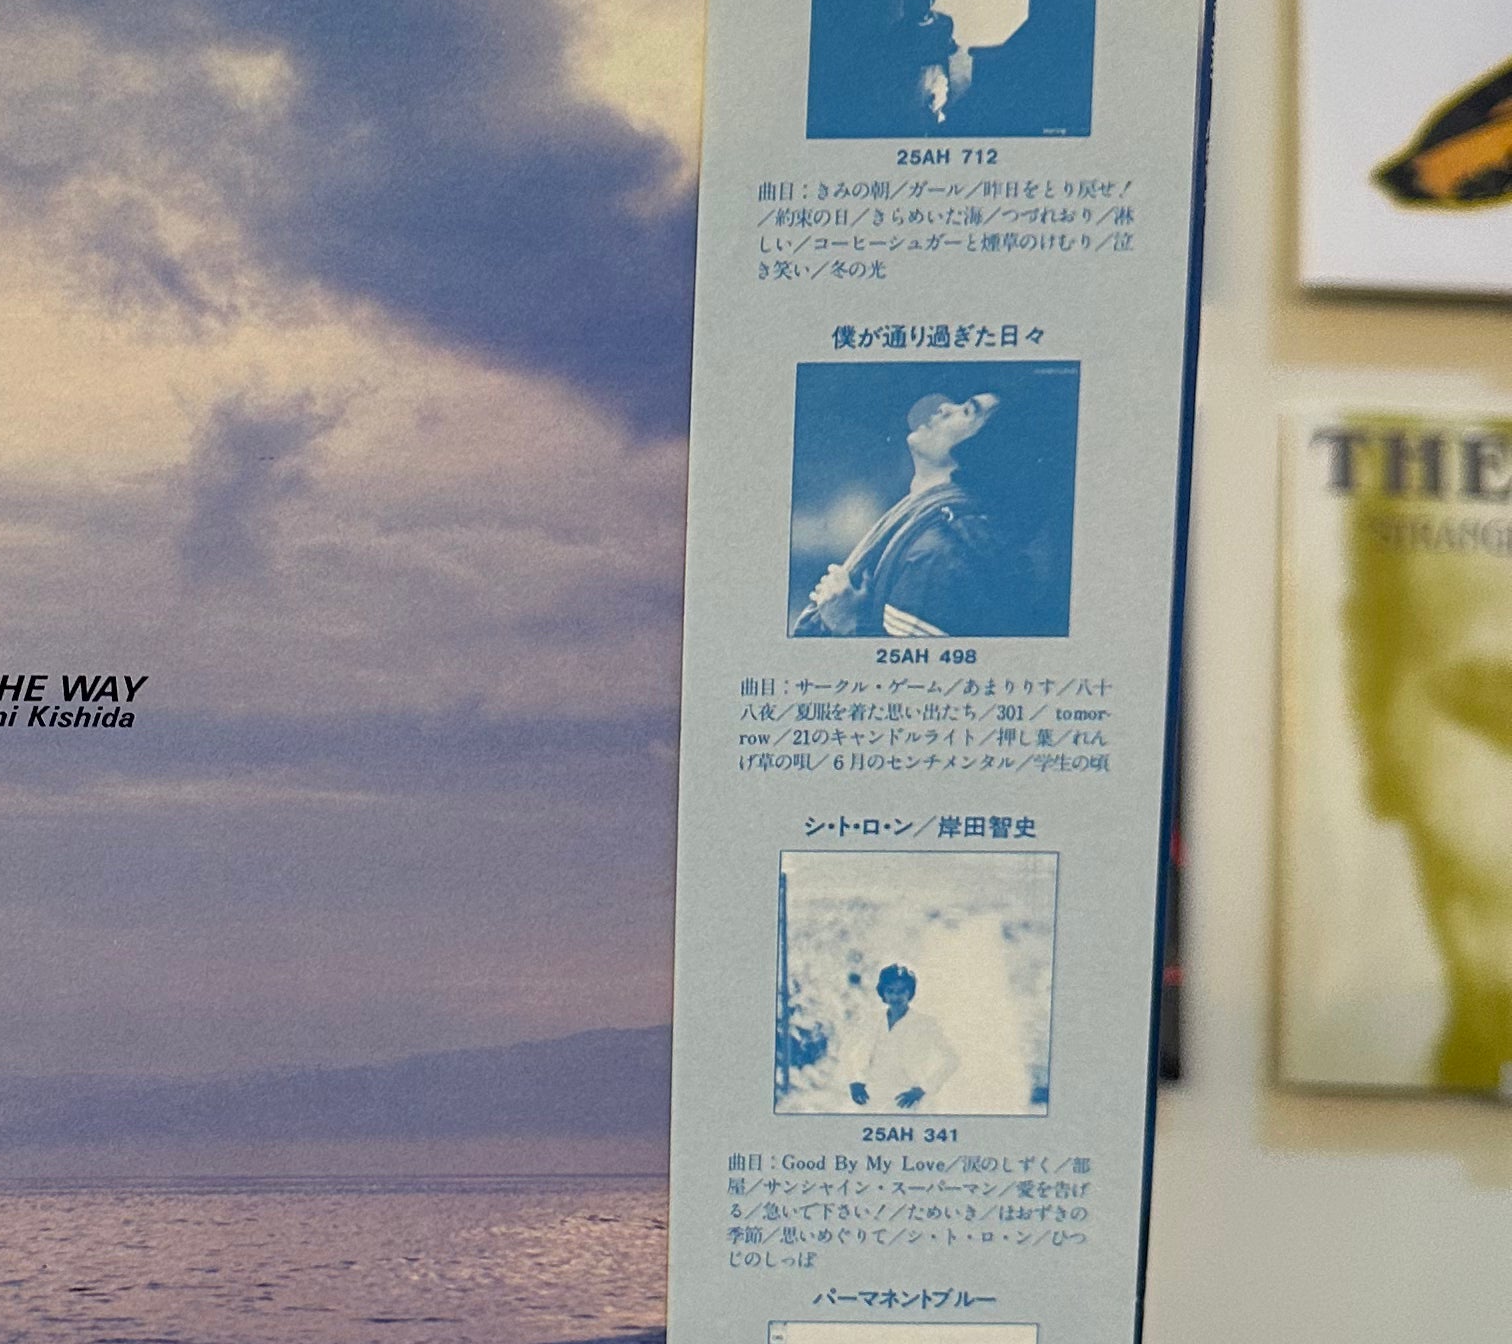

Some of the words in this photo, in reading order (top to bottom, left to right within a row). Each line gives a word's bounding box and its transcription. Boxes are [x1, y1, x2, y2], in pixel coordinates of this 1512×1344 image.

[896, 149, 950, 166] 25AH
[962, 149, 999, 166] 712
[831, 323, 1045, 350] 僕が通り過ぎた日々
[875, 648, 929, 665] 25AH
[939, 648, 978, 665] 498
[61, 674, 150, 703] WAY
[27, 705, 136, 728] Kishida
[862, 1126, 915, 1143] 25AH
[923, 1127, 959, 1143] 341
[834, 1153, 859, 1174] By
[865, 1154, 891, 1175] My
[812, 1287, 997, 1310] パーマネントブルー
